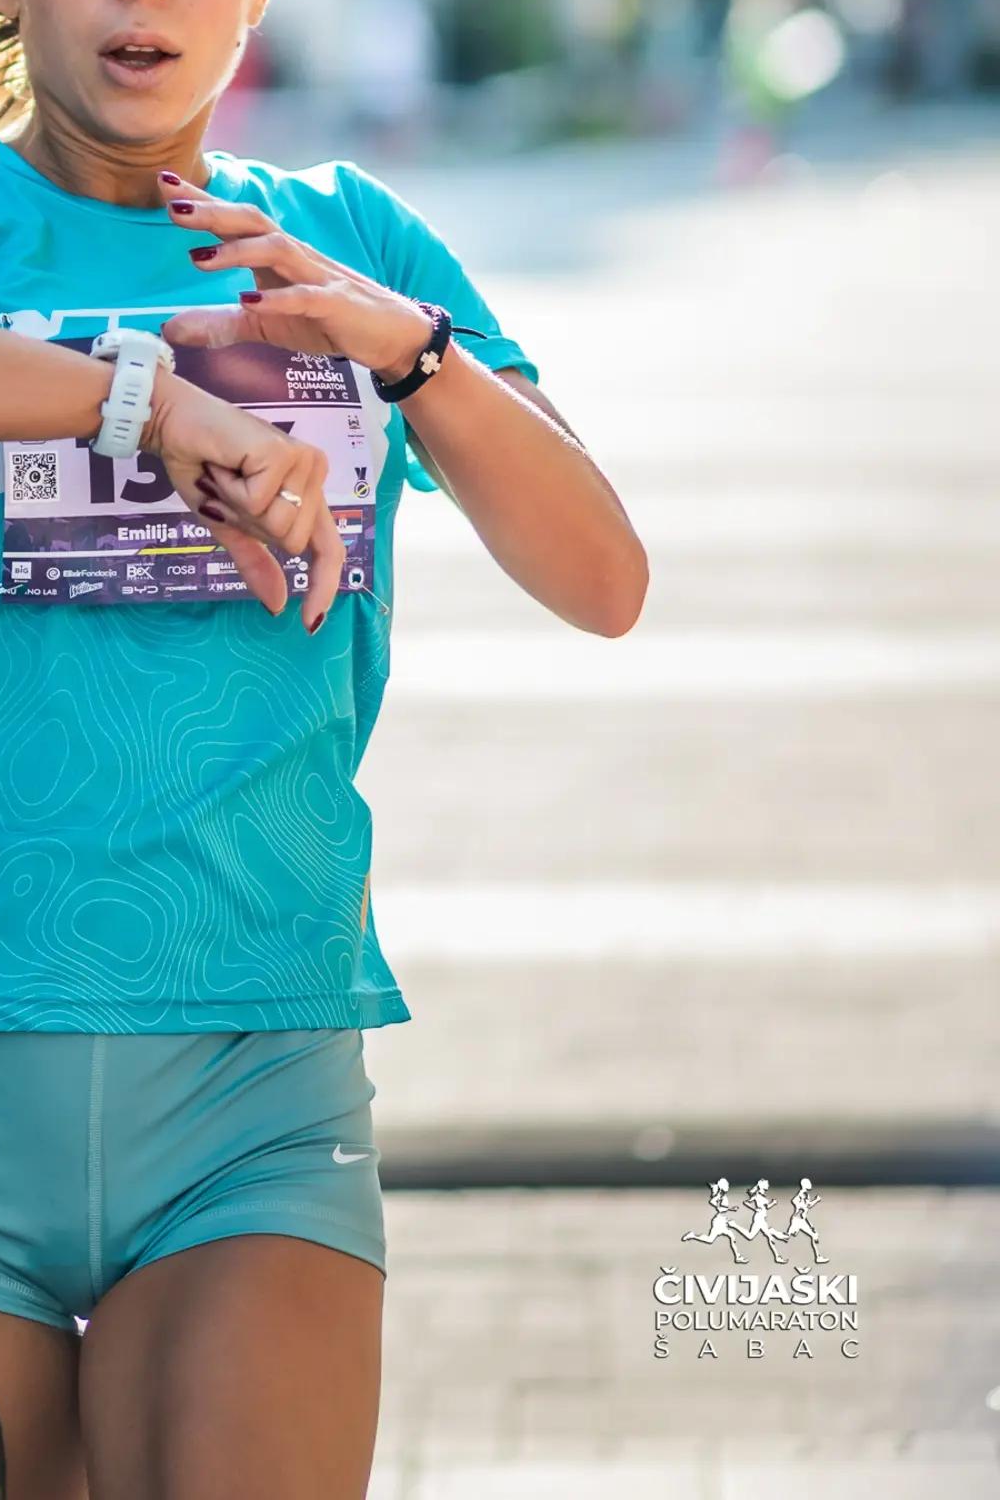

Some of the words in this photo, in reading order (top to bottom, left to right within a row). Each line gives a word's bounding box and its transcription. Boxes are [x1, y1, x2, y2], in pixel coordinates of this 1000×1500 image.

[286, 368, 344, 382] ČIVIJAŠKI
[288, 382, 346, 390] POLUMARATON
[118, 524, 177, 542] Emilija
[167, 565, 195, 575] rosa
[122, 585, 158, 594] BYD
[225, 581, 247, 591] SPOR
